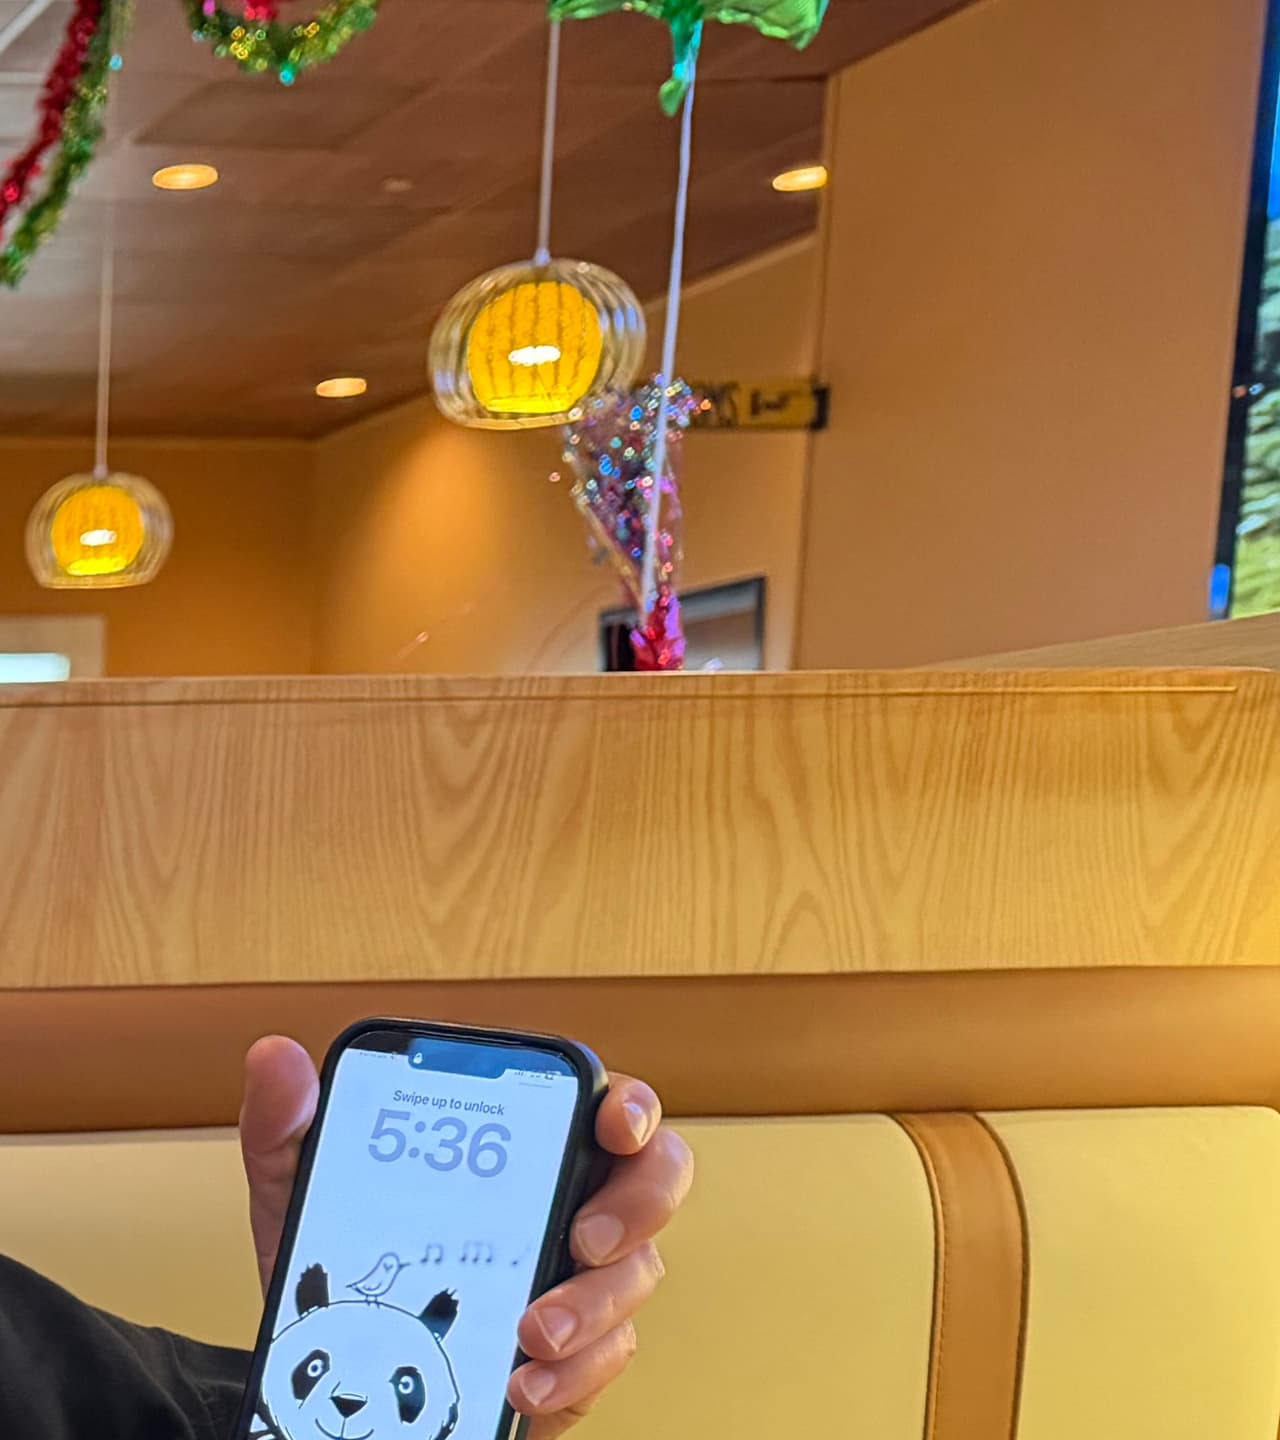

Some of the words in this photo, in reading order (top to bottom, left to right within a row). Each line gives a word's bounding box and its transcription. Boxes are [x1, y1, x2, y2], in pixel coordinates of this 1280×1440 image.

[393, 1090, 429, 1106] Swipe
[432, 1097, 447, 1109] up
[450, 1098, 462, 1109] to
[465, 1101, 505, 1115] unlock
[368, 1108, 511, 1178] 5:36
